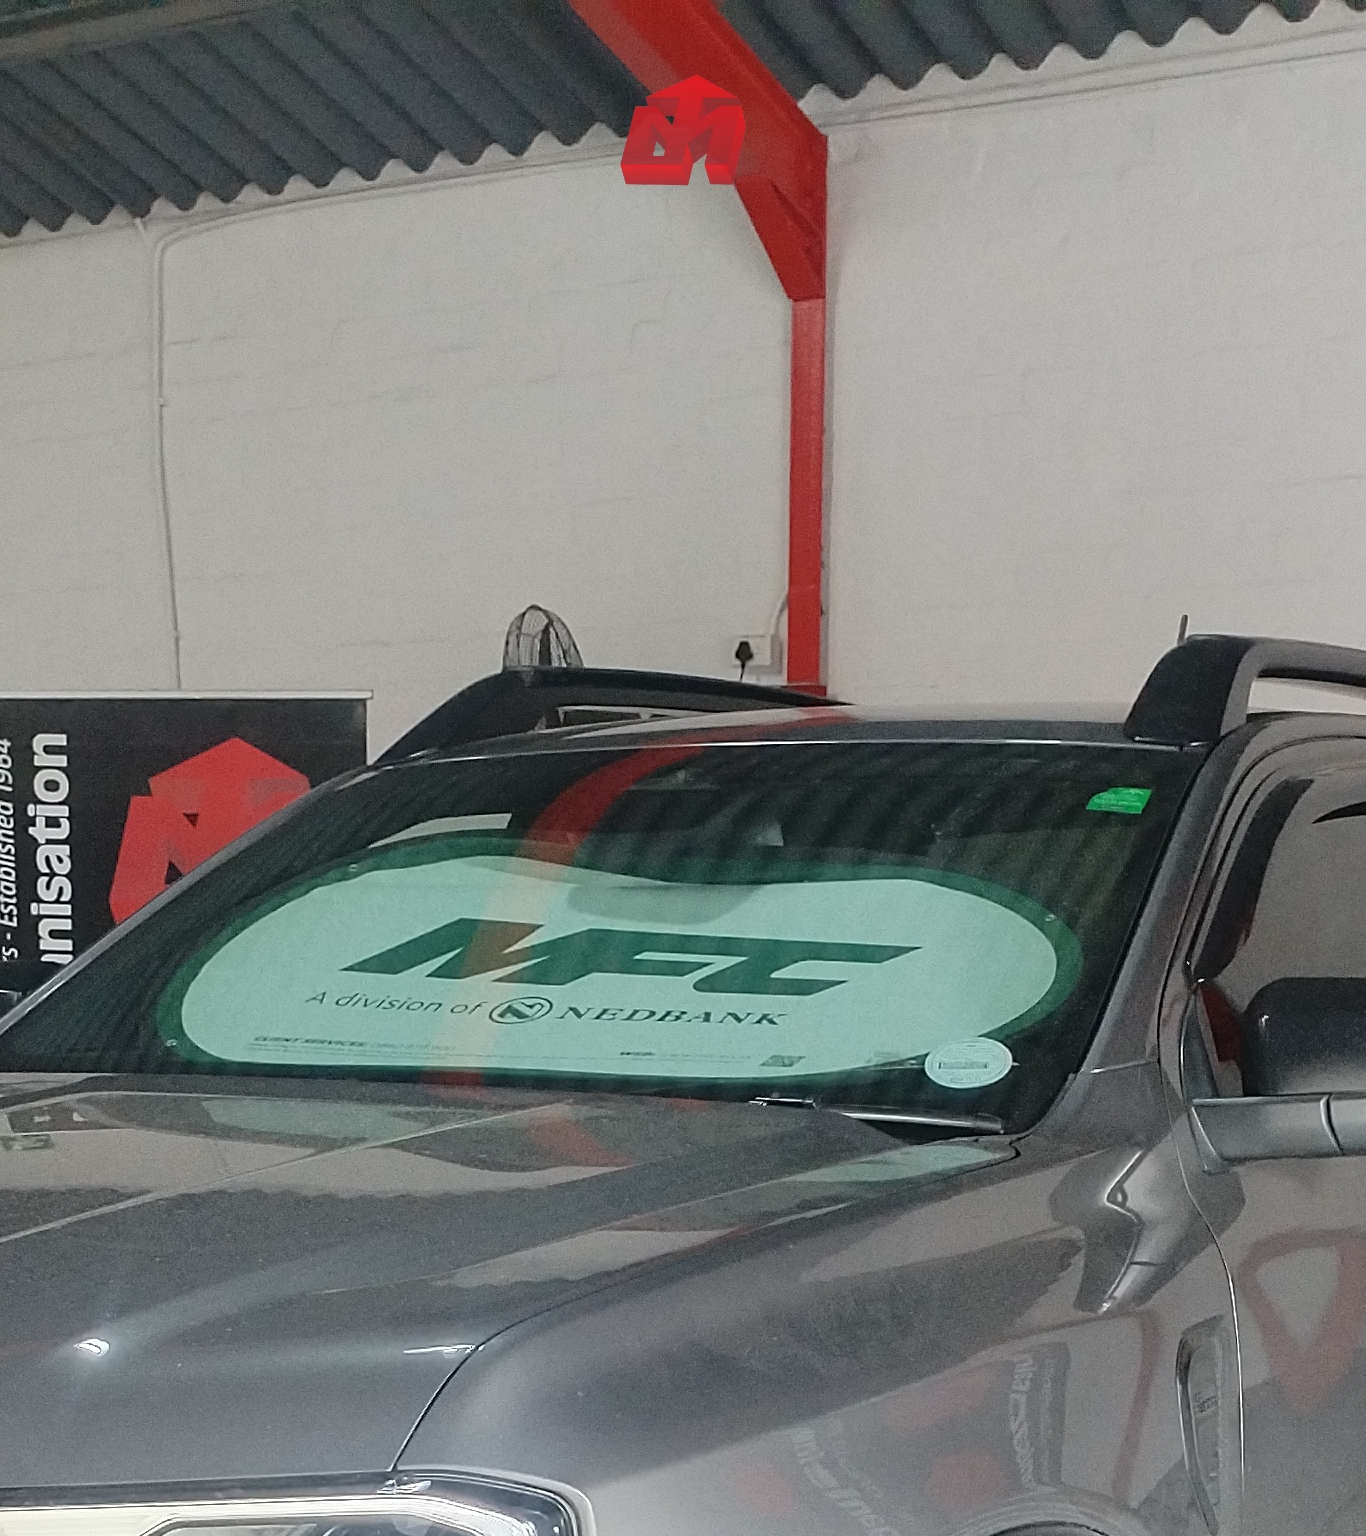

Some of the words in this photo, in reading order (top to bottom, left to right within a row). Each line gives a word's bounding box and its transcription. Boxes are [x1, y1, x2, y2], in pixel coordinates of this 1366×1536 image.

[340, 917, 923, 997] MFC
[307, 991, 327, 1003] A
[334, 992, 441, 1015] division
[450, 1000, 488, 1016] of
[554, 1005, 784, 1027] NEDBANK
